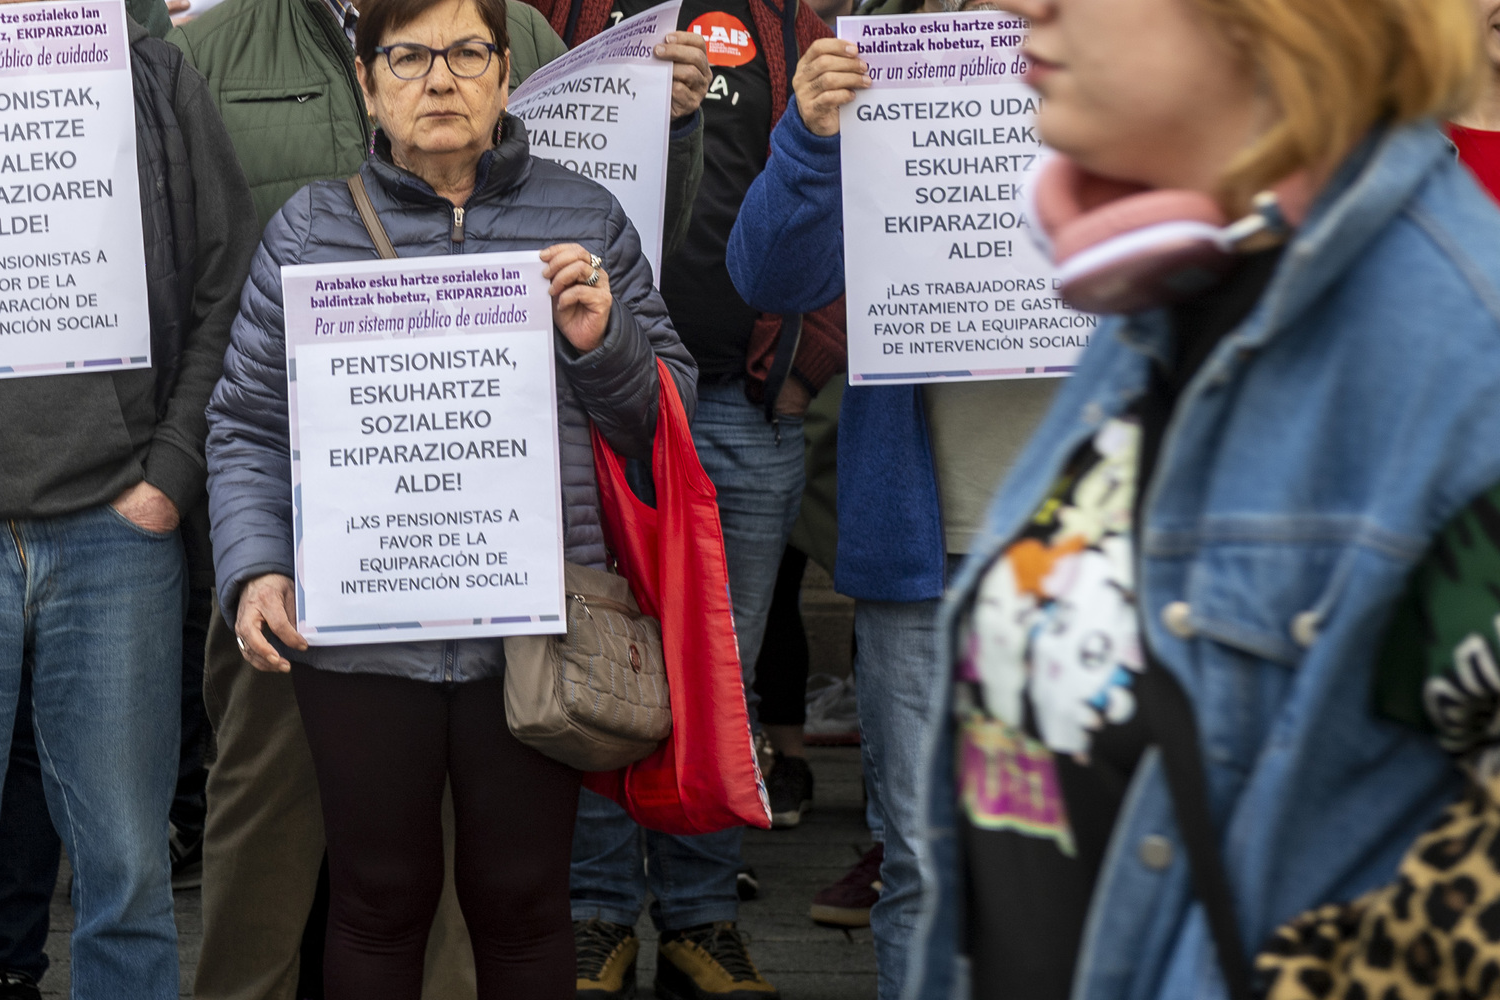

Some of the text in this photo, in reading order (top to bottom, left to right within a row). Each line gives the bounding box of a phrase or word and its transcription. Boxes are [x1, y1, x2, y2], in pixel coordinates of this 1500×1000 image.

[693, 25, 749, 47] LAB
[315, 267, 520, 292] Arabako esku hartze sozialeko lan
[310, 284, 527, 309] baldintzak hobetuz, EKIPARAZIOA!
[314, 303, 527, 336] Por un sistema público de cuidados
[331, 347, 517, 376] PENTSIONISTAK,
[350, 378, 501, 406] ESKUHARTZE
[361, 409, 492, 435] SOZIALEKO
[329, 438, 527, 467] EKIPARAZIOAREN
[394, 472, 462, 494] ALDE!
[346, 508, 520, 533] ¡LXS PENSIONISTAS A
[379, 532, 487, 550] FAVOR DE LA
[360, 551, 508, 574] EQUIPARACIÓN DE
[341, 572, 528, 594] INTERVENCIÓN SOCIAL!
